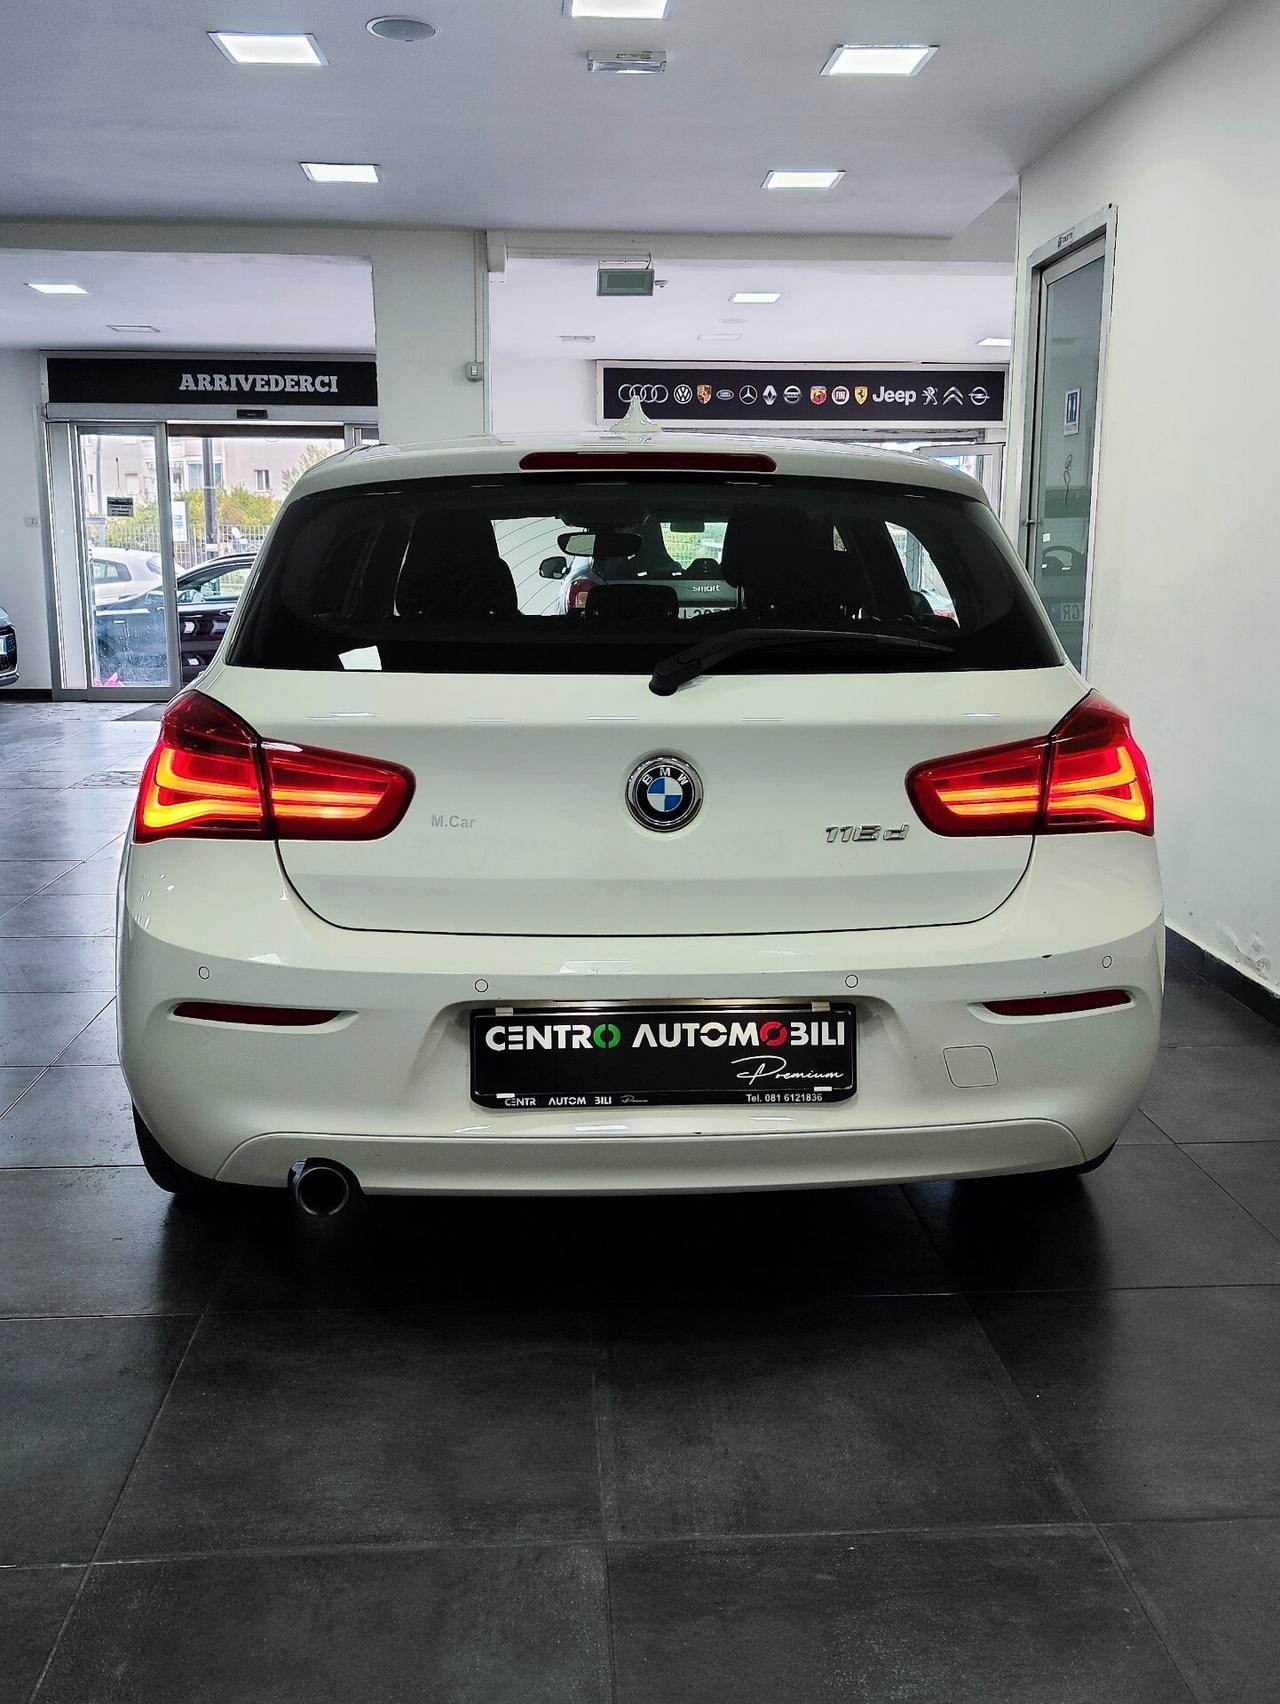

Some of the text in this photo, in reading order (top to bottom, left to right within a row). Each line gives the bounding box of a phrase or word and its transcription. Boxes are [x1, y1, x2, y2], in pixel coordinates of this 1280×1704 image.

[178, 373, 339, 393] ARRIVEDERCI
[872, 385, 917, 406] Jeep
[642, 767, 689, 786] BMW
[431, 814, 476, 828] M.Car
[485, 1021, 845, 1051] CENTRO AUTOMOBILI
[730, 1055, 844, 1086] Premium
[745, 1093, 763, 1103] Tel.
[764, 1093, 782, 1102] 081
